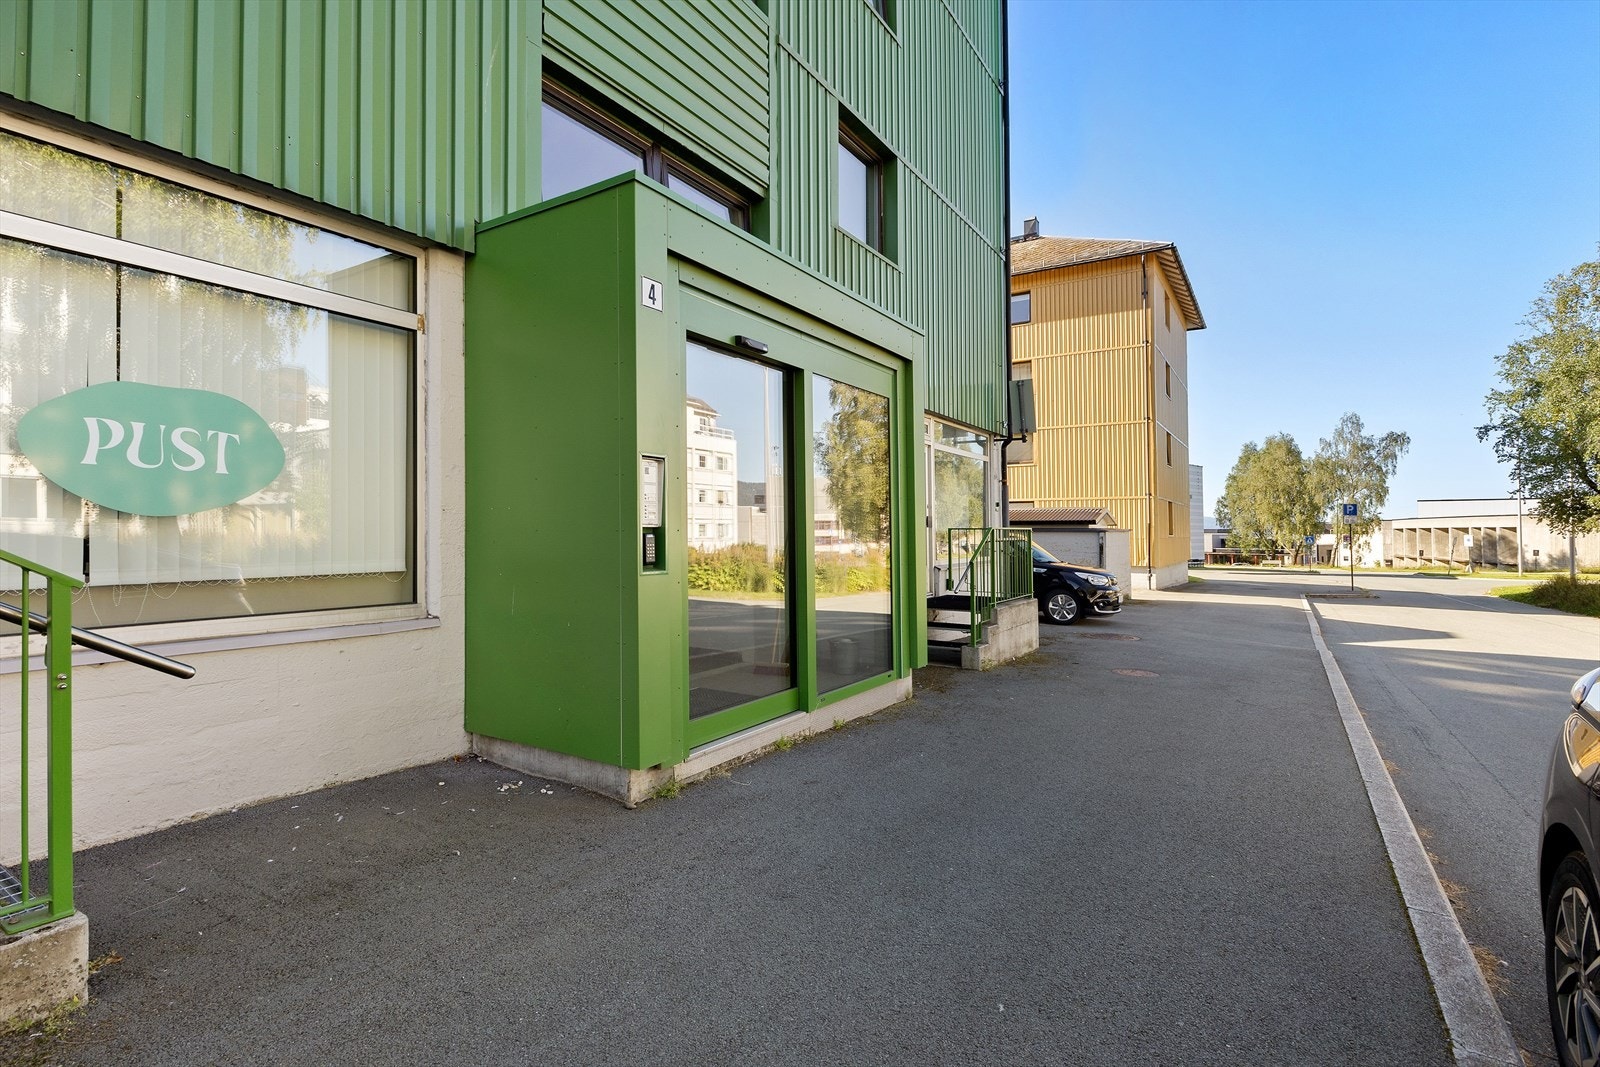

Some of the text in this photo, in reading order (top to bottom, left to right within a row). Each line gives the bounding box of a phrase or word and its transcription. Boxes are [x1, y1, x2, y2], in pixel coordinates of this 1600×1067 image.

[648, 283, 657, 306] 4
[80, 416, 241, 475] PUST
[1346, 504, 1354, 515] P
